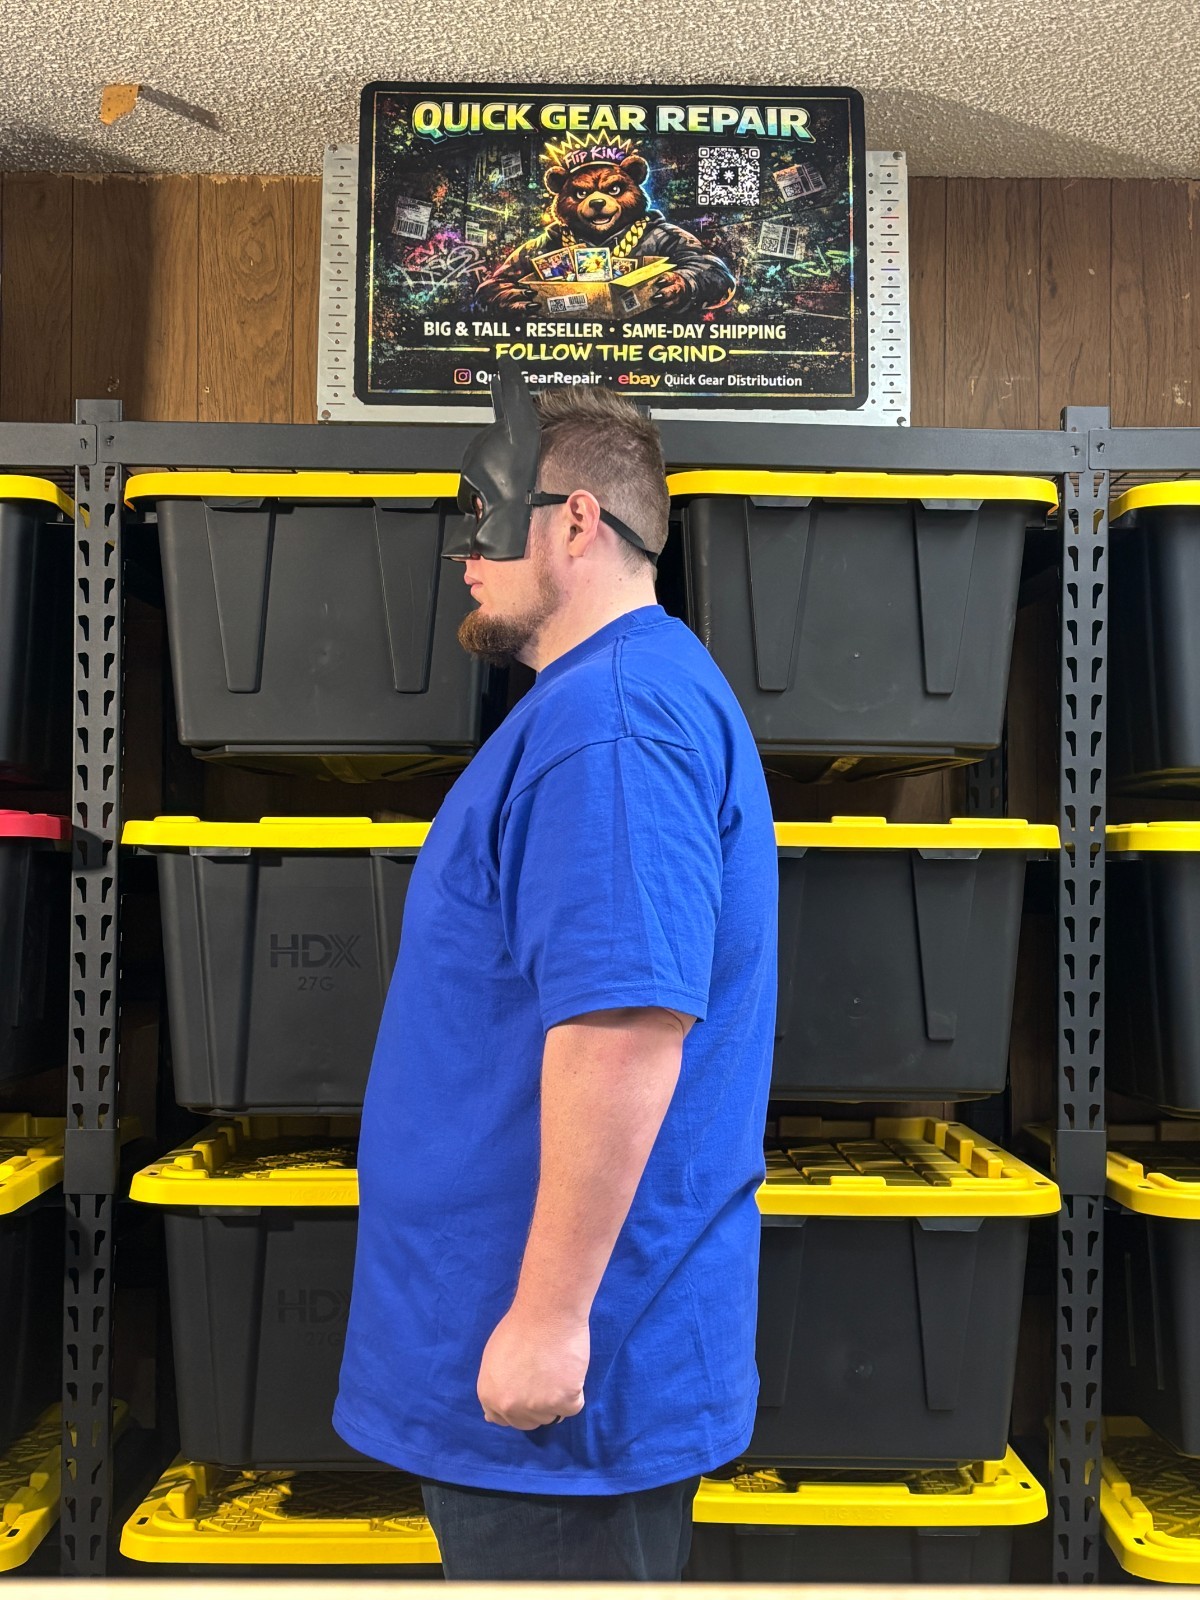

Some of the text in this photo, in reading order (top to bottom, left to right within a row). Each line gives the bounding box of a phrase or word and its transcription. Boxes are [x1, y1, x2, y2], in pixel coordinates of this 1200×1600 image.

[413, 102, 813, 142] QUICK GEAR REPAIR
[424, 321, 786, 340] BIG & TALL RESELLER SAME-DAY SHIPPING
[495, 343, 727, 363] FOLLOW THE GRIND
[618, 371, 661, 387] ebay
[664, 373, 696, 387] Quick
[698, 374, 725, 387] Gear
[728, 374, 802, 387] Distribution
[270, 933, 361, 968] HDX
[298, 976, 334, 991] 27G
